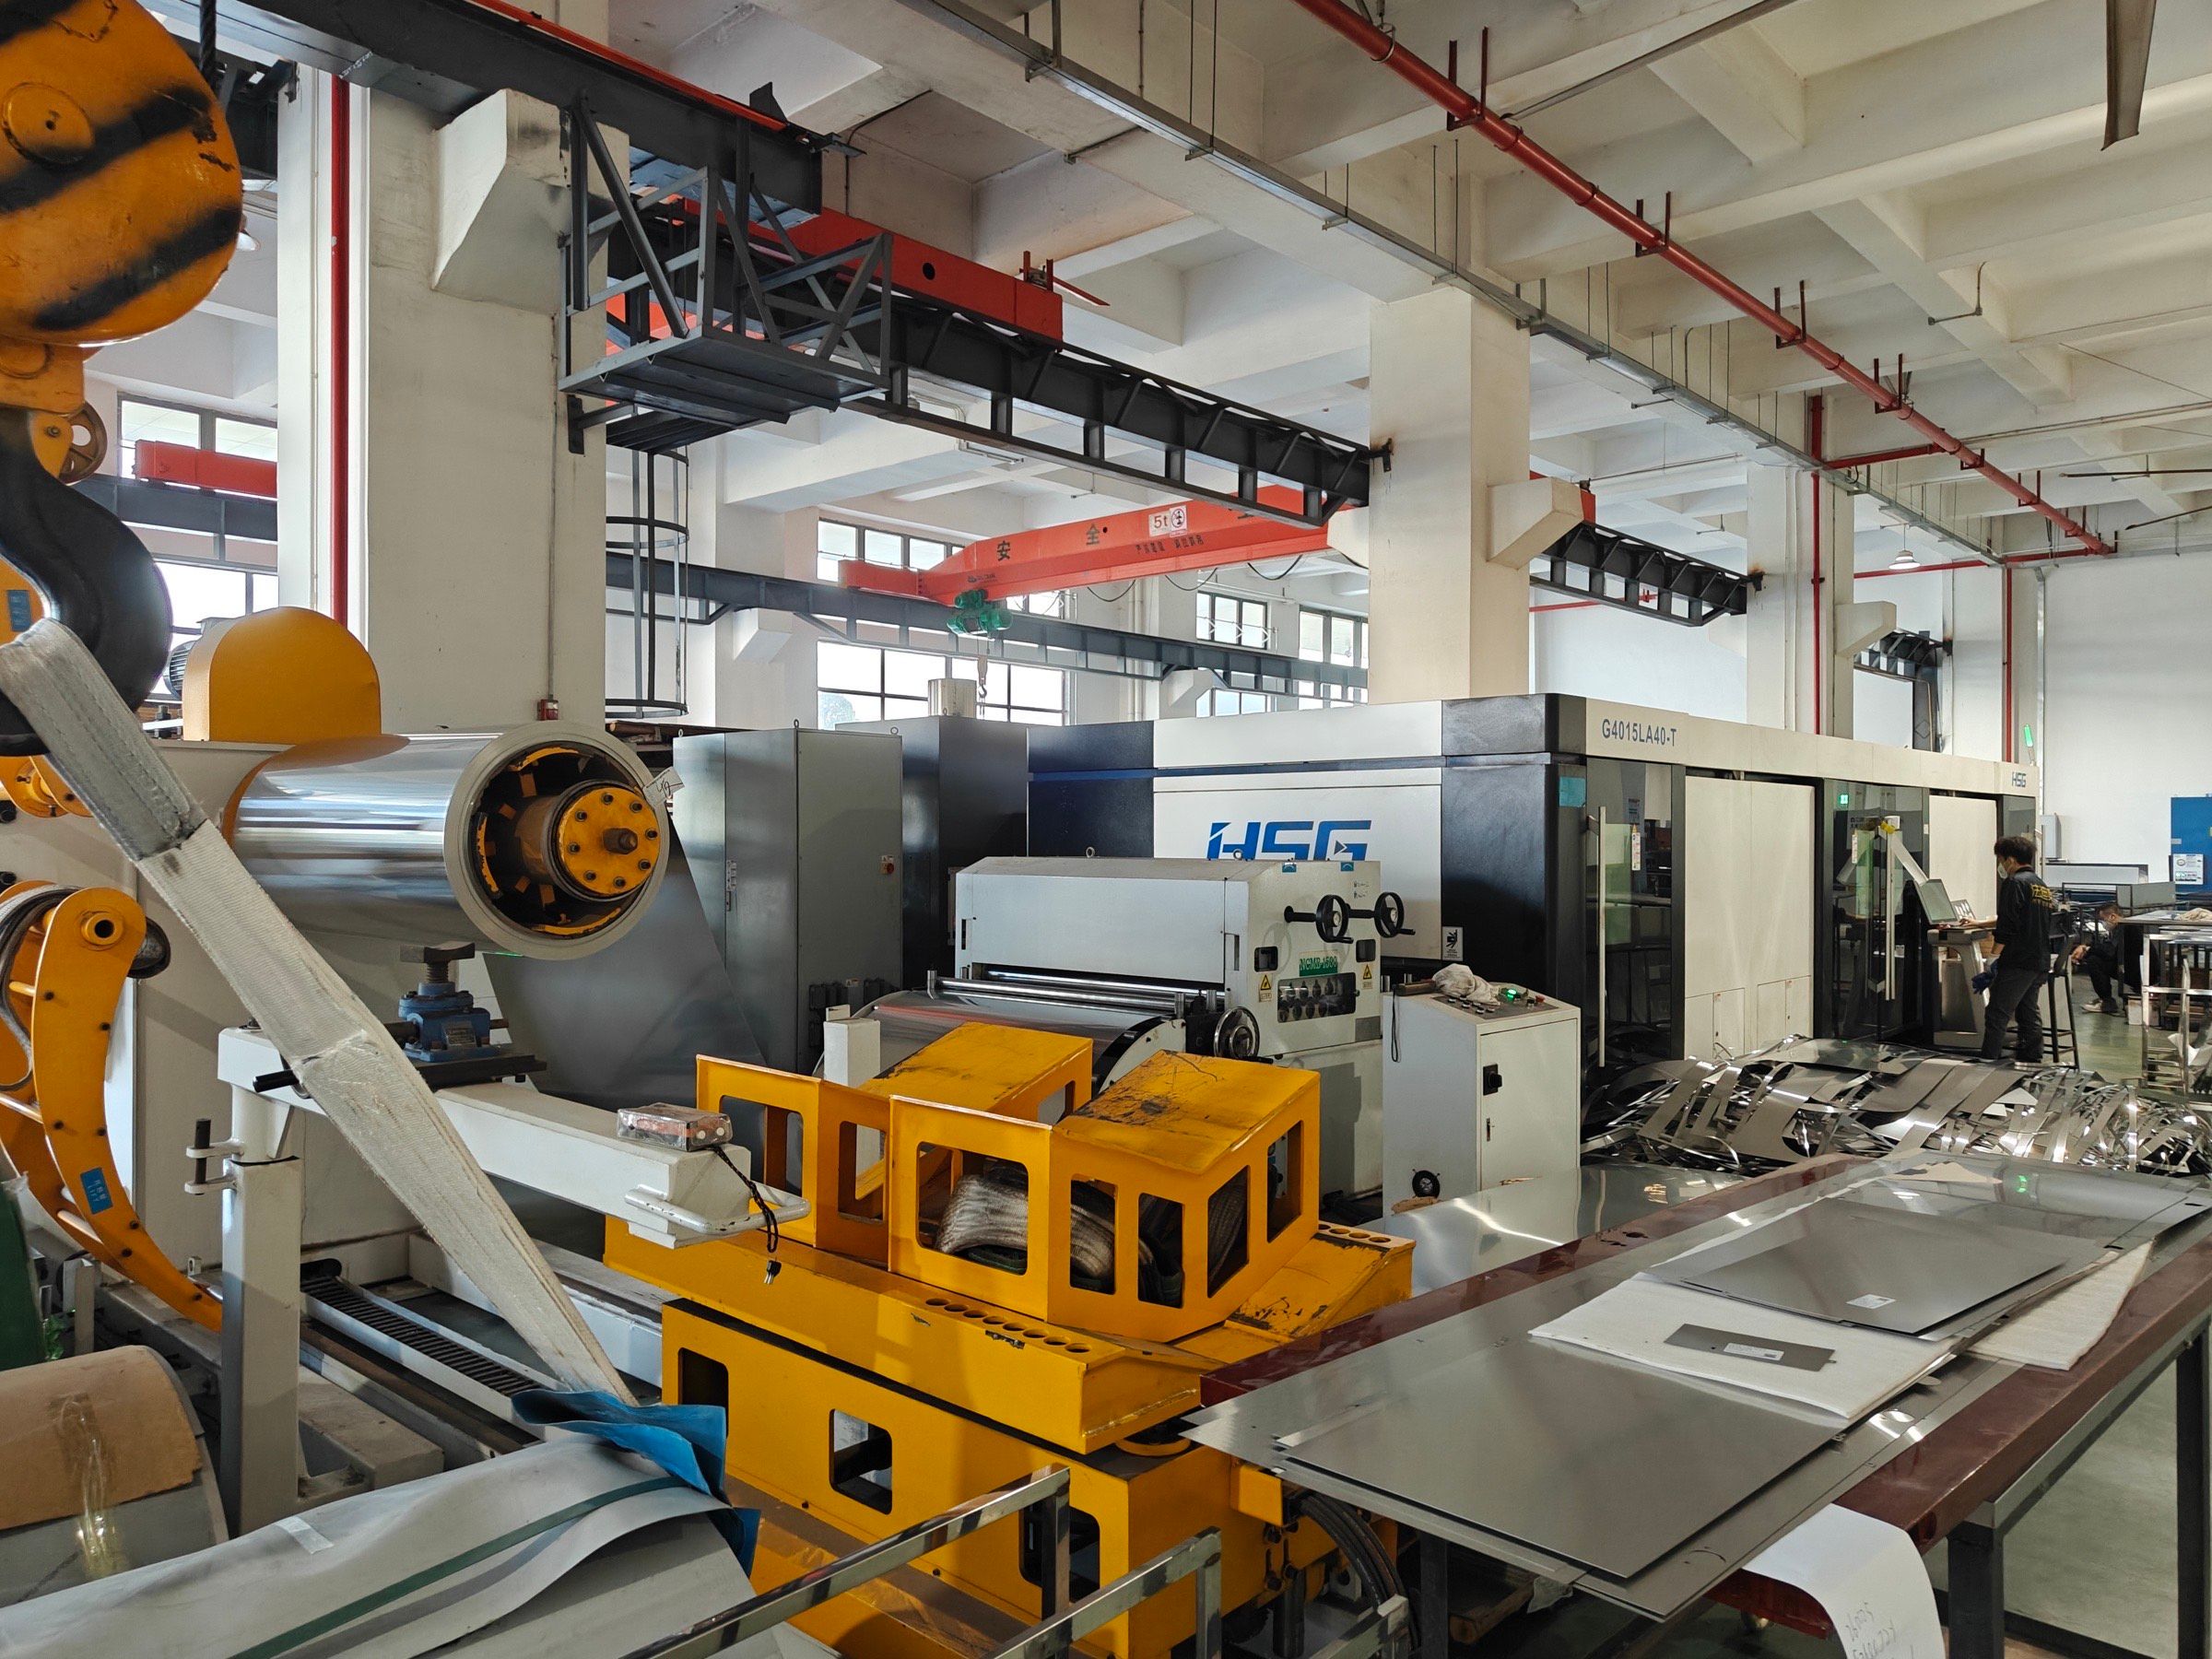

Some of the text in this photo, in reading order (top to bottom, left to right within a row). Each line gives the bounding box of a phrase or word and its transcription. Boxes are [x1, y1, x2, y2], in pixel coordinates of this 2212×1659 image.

[1154, 514, 1168, 529] 5t
[996, 524, 1100, 561] 安 全
[1602, 718, 1677, 747] G4015LA40-T
[2012, 771, 2027, 787] HSG
[1206, 819, 1372, 861] HSG
